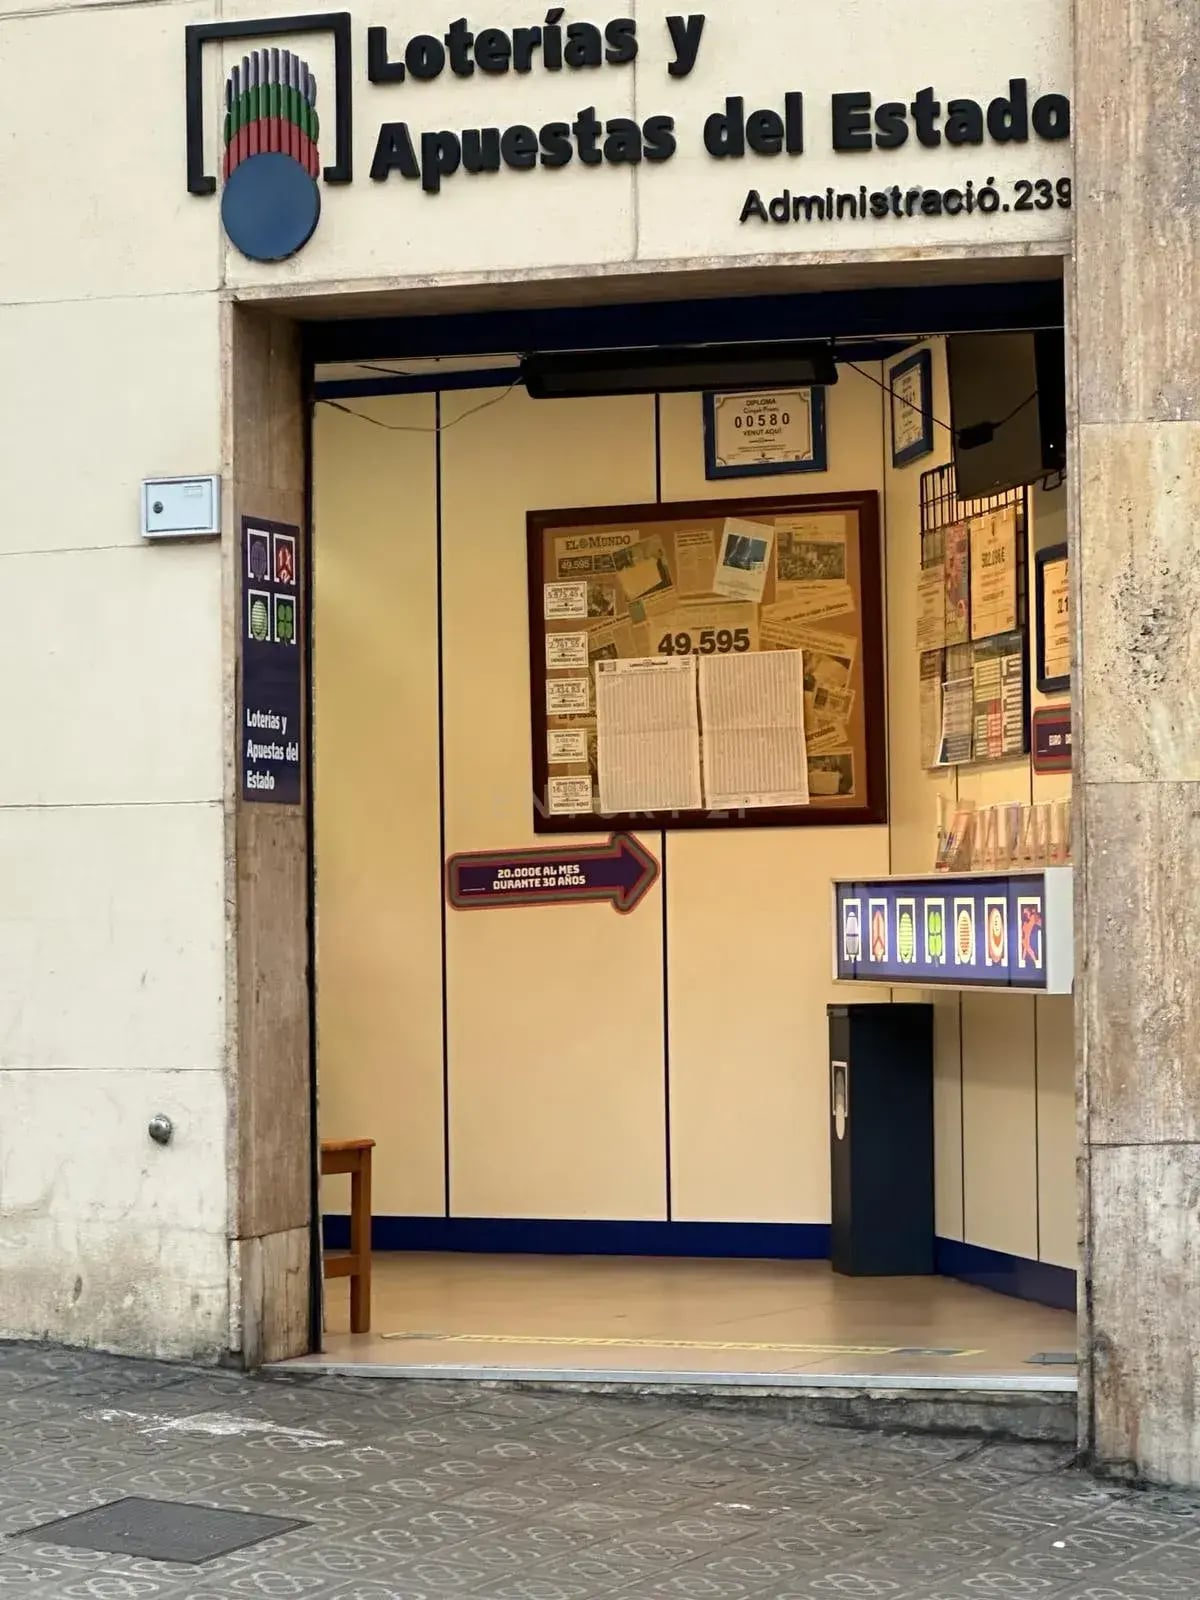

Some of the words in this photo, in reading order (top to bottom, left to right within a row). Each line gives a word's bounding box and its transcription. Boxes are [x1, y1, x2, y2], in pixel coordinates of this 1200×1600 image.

[368, 8, 639, 86] Loterías
[666, 14, 706, 79] y
[370, 106, 677, 195] Apuestas
[704, 91, 804, 160] del
[832, 78, 1071, 154] Estado
[745, 398, 776, 406] DIPLOMA
[588, 535, 631, 549] MUNDO
[658, 628, 750, 656] 49.595
[246, 708, 280, 730] Loterías
[281, 715, 288, 735] y
[246, 739, 284, 763] Apuestas
[286, 742, 299, 762] del
[246, 770, 275, 790] Estado
[492, 878, 541, 890] DURANTE
[542, 877, 556, 887] 30
[557, 874, 586, 886] AÑOS
[497, 867, 542, 879] 20.000€
[543, 866, 557, 876] AL
[558, 864, 580, 875] MES
